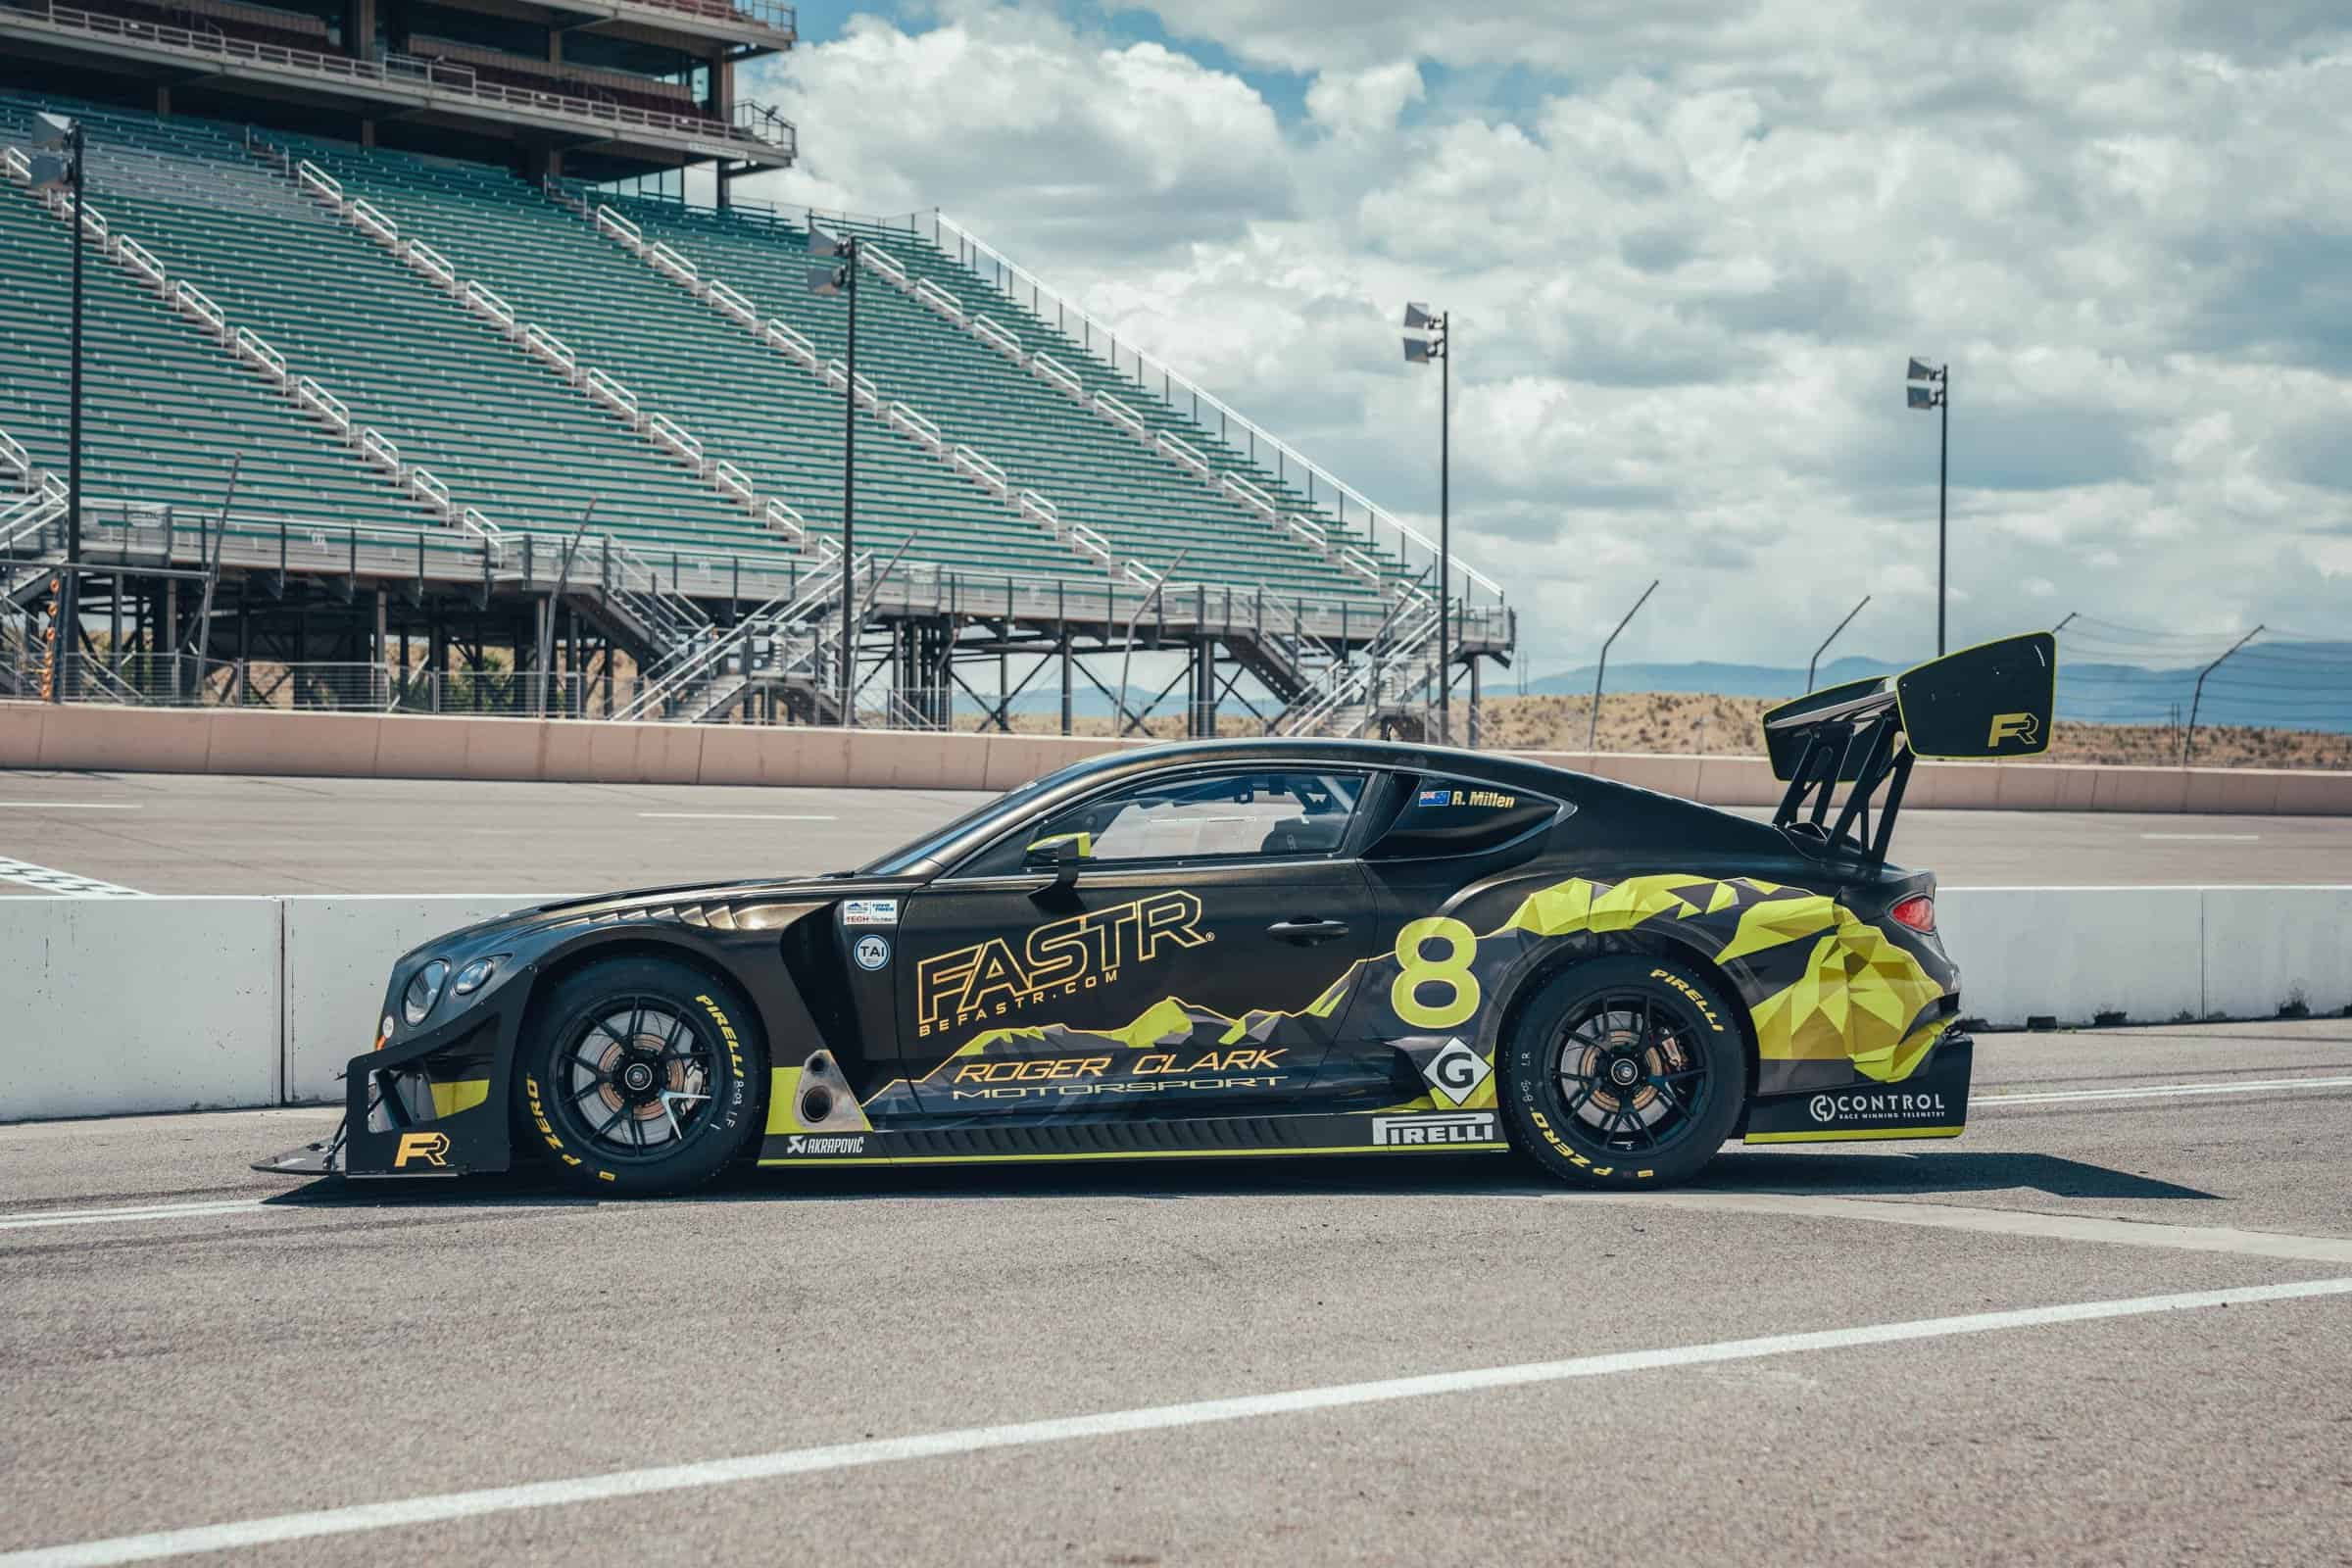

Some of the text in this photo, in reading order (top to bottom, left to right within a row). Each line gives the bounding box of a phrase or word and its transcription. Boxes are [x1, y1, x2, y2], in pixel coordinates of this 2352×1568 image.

[1451, 791, 1515, 808] R. Millen
[859, 946, 885, 957] TAI
[1391, 916, 1481, 1028] 8
[1649, 968, 1725, 1032] PIRELLI
[695, 995, 745, 1078] PIRELLI
[955, 1049, 1289, 1083] ROGER CLARK
[1437, 1052, 1474, 1089] G
[954, 1075, 1289, 1101] MOTORSPORT
[1838, 1093, 1945, 1112] CONTROL
[526, 1076, 564, 1151] ZERO
[1372, 1112, 1494, 1146] PIRELLI
[1531, 1112, 1592, 1168] ZERO
